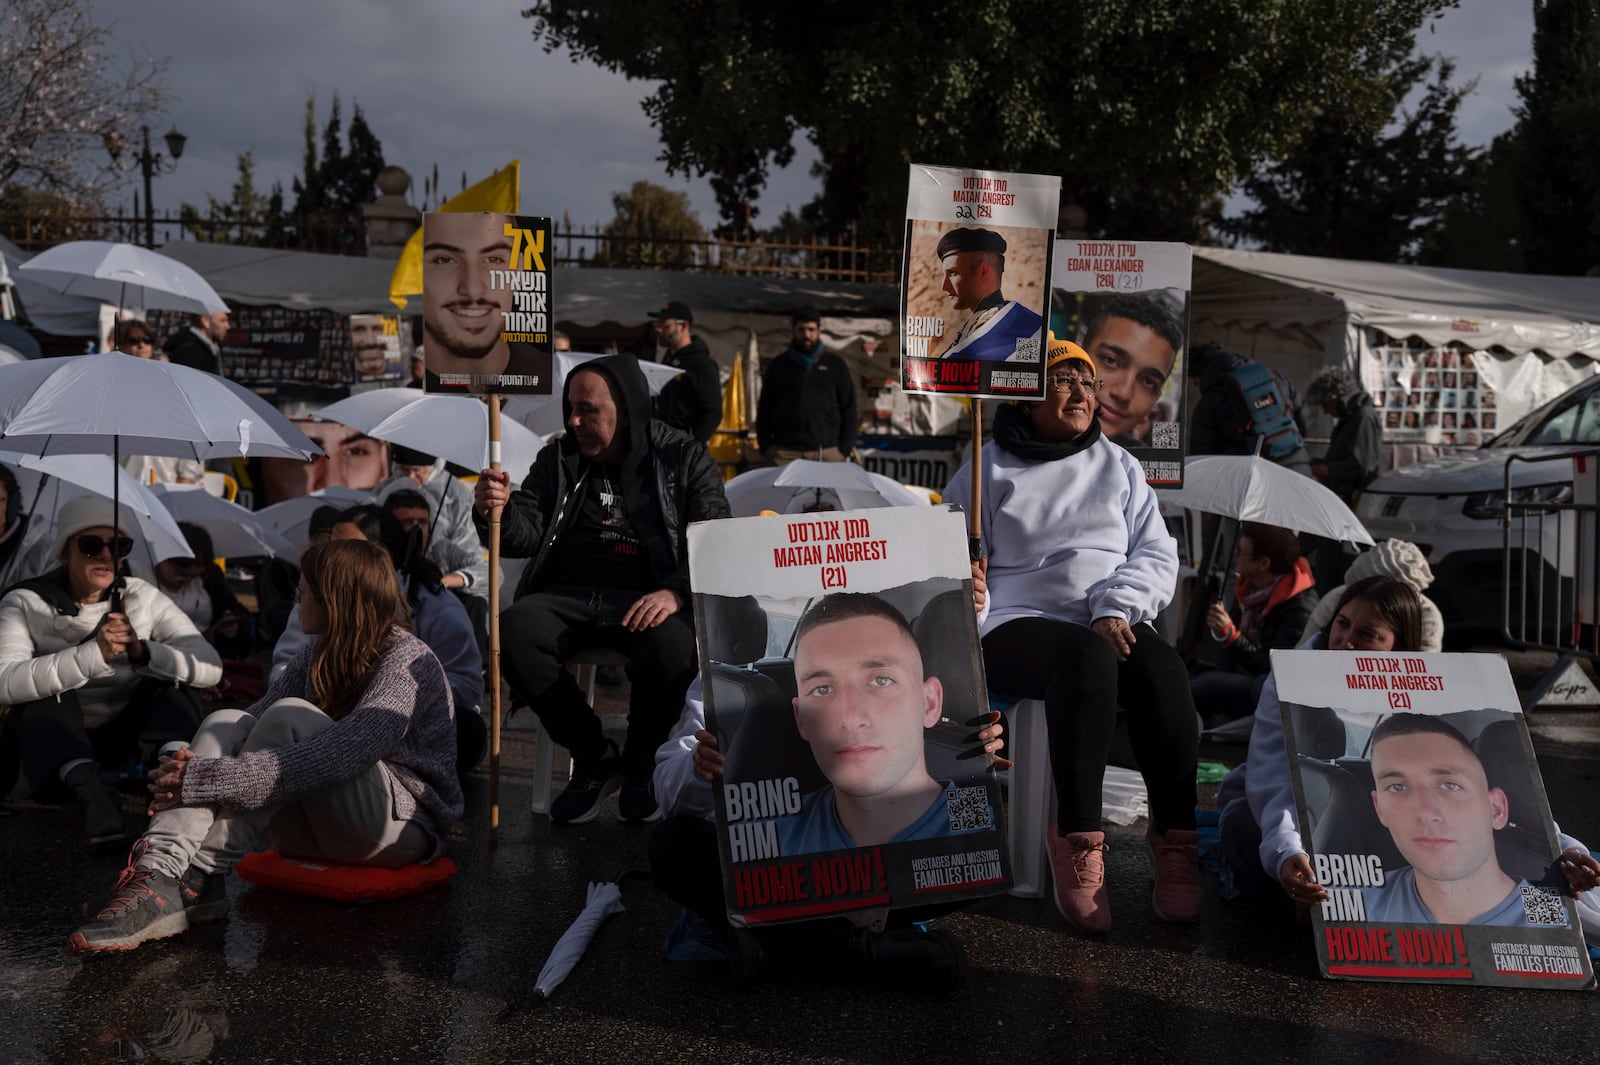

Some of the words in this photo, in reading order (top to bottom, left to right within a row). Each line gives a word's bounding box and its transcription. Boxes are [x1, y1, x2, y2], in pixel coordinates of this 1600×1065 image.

[963, 177, 992, 191] אנגרסט
[994, 179, 1007, 192] מתן
[953, 190, 980, 204] MATAN
[982, 193, 1015, 206] ANGREST
[955, 206, 976, 219] 22
[504, 223, 546, 271] אל
[1077, 243, 1114, 257] אלכסנדר
[1117, 244, 1136, 258] עידן
[1068, 258, 1091, 272] EDAN
[1093, 258, 1144, 272] ALEXANDER
[489, 270, 546, 292] תשאירו
[513, 291, 547, 312] אותי
[501, 312, 548, 332] מאחור
[907, 316, 944, 338] BRING
[906, 337, 928, 358] HIM
[1048, 346, 1068, 360] NOW
[906, 360, 938, 382] HOME
[941, 360, 980, 383] NOW!
[992, 378, 1017, 388] FAMILIES
[1018, 378, 1039, 388] FORUM
[1156, 470, 1180, 480] FORUM
[788, 520, 839, 544] אנגרסט
[845, 518, 870, 542] מתן
[774, 545, 822, 568] MATAN
[826, 540, 888, 564] ANGREST
[821, 566, 847, 590] (21)
[1355, 657, 1400, 673] אנגרסט
[1404, 658, 1426, 674] מתן
[1346, 674, 1388, 690] MATAN
[1391, 675, 1444, 692] ANGREST
[1388, 692, 1412, 710] (21)
[724, 776, 802, 822] BRING
[728, 820, 780, 864] HIM
[912, 856, 950, 872] HOSTAGES
[950, 854, 966, 868] AND
[966, 849, 1000, 866] MISSING
[1315, 854, 1384, 887] BRING
[735, 862, 810, 908] HOME
[812, 848, 888, 898] NOW!
[914, 868, 962, 890] FAMILIES
[964, 860, 1002, 884] FORUM
[1321, 888, 1366, 922] HIM
[1325, 926, 1394, 962] HOME
[1396, 926, 1469, 966] NOW!
[1492, 942, 1530, 956] HOSTAGES
[1530, 944, 1545, 956] AND
[1545, 945, 1578, 958] MISSING
[1494, 954, 1542, 974] FAMILIES
[1544, 957, 1584, 976] FORUM
